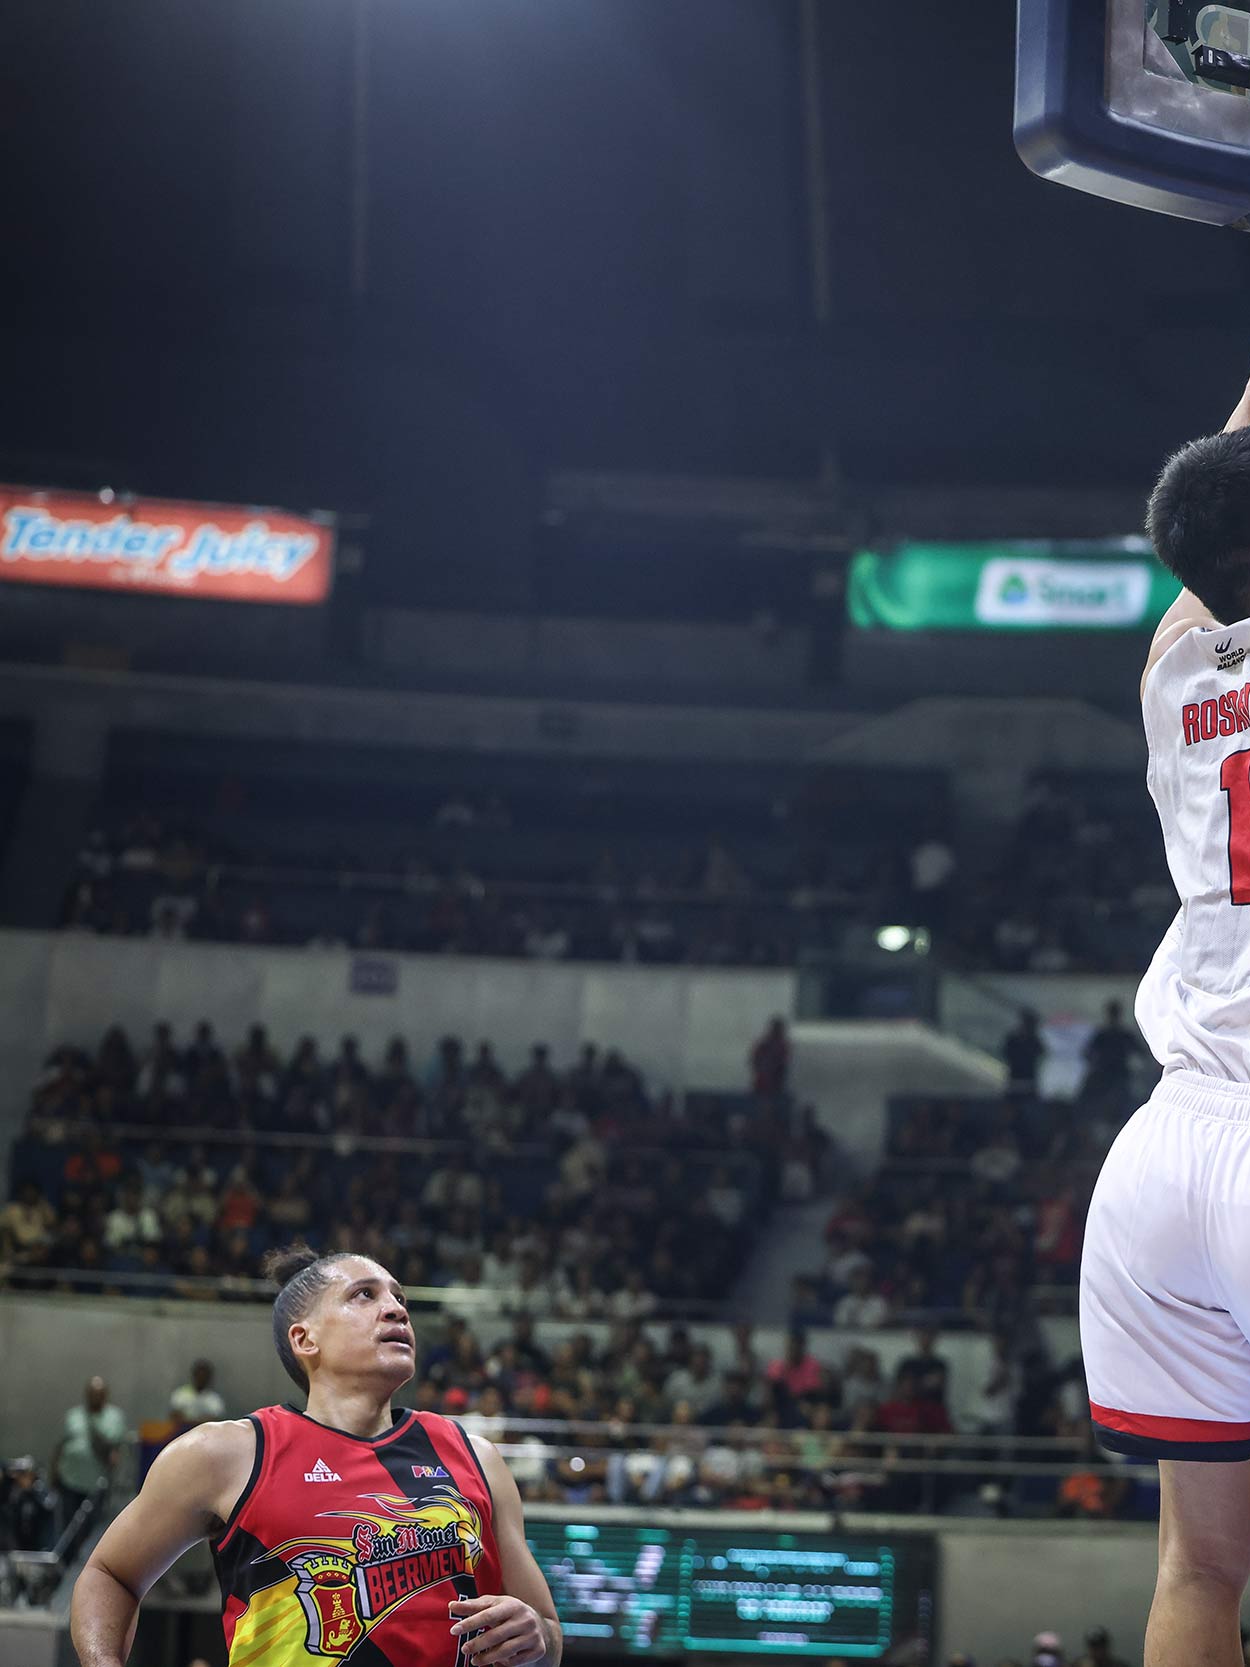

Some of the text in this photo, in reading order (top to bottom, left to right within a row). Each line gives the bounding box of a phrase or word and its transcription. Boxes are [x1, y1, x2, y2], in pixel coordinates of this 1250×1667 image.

[2, 506, 184, 562] Tender
[167, 523, 320, 582] Juicy
[1219, 648, 1244, 663] WORLD
[304, 1472, 342, 1482] DELTA
[356, 1521, 460, 1562] San Miguel
[365, 1544, 466, 1615] BEERMEN
